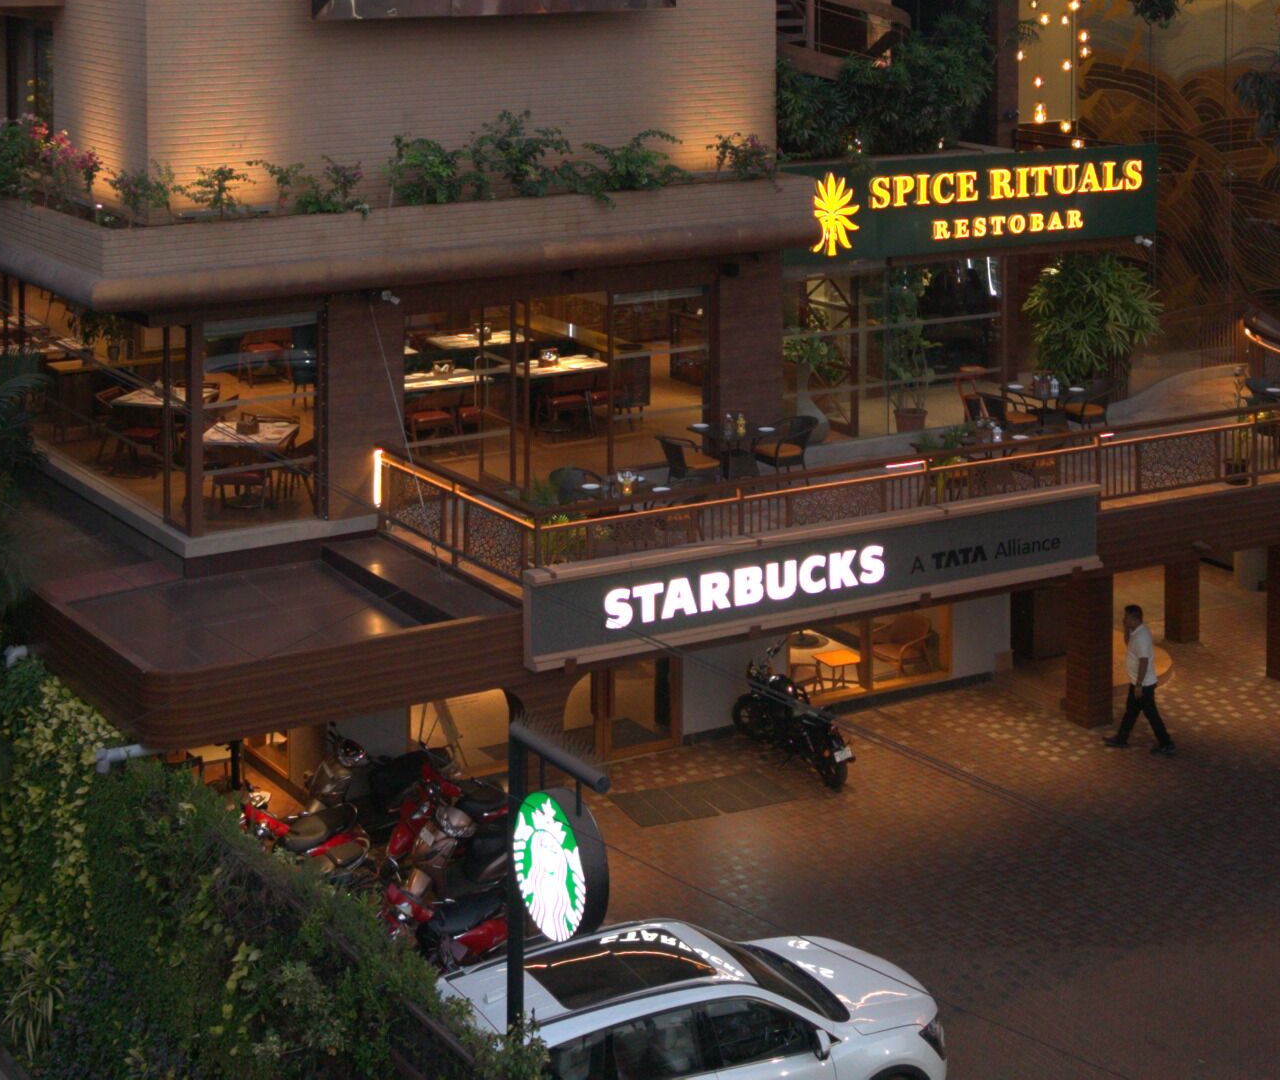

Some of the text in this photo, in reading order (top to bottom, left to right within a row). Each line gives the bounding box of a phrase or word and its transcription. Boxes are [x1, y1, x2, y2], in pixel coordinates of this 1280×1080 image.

[870, 159, 1144, 210] SPICE RITUALS
[932, 209, 1084, 241] RESTOBAR
[603, 534, 1062, 630] STARBUCKS A TATA Alliance
